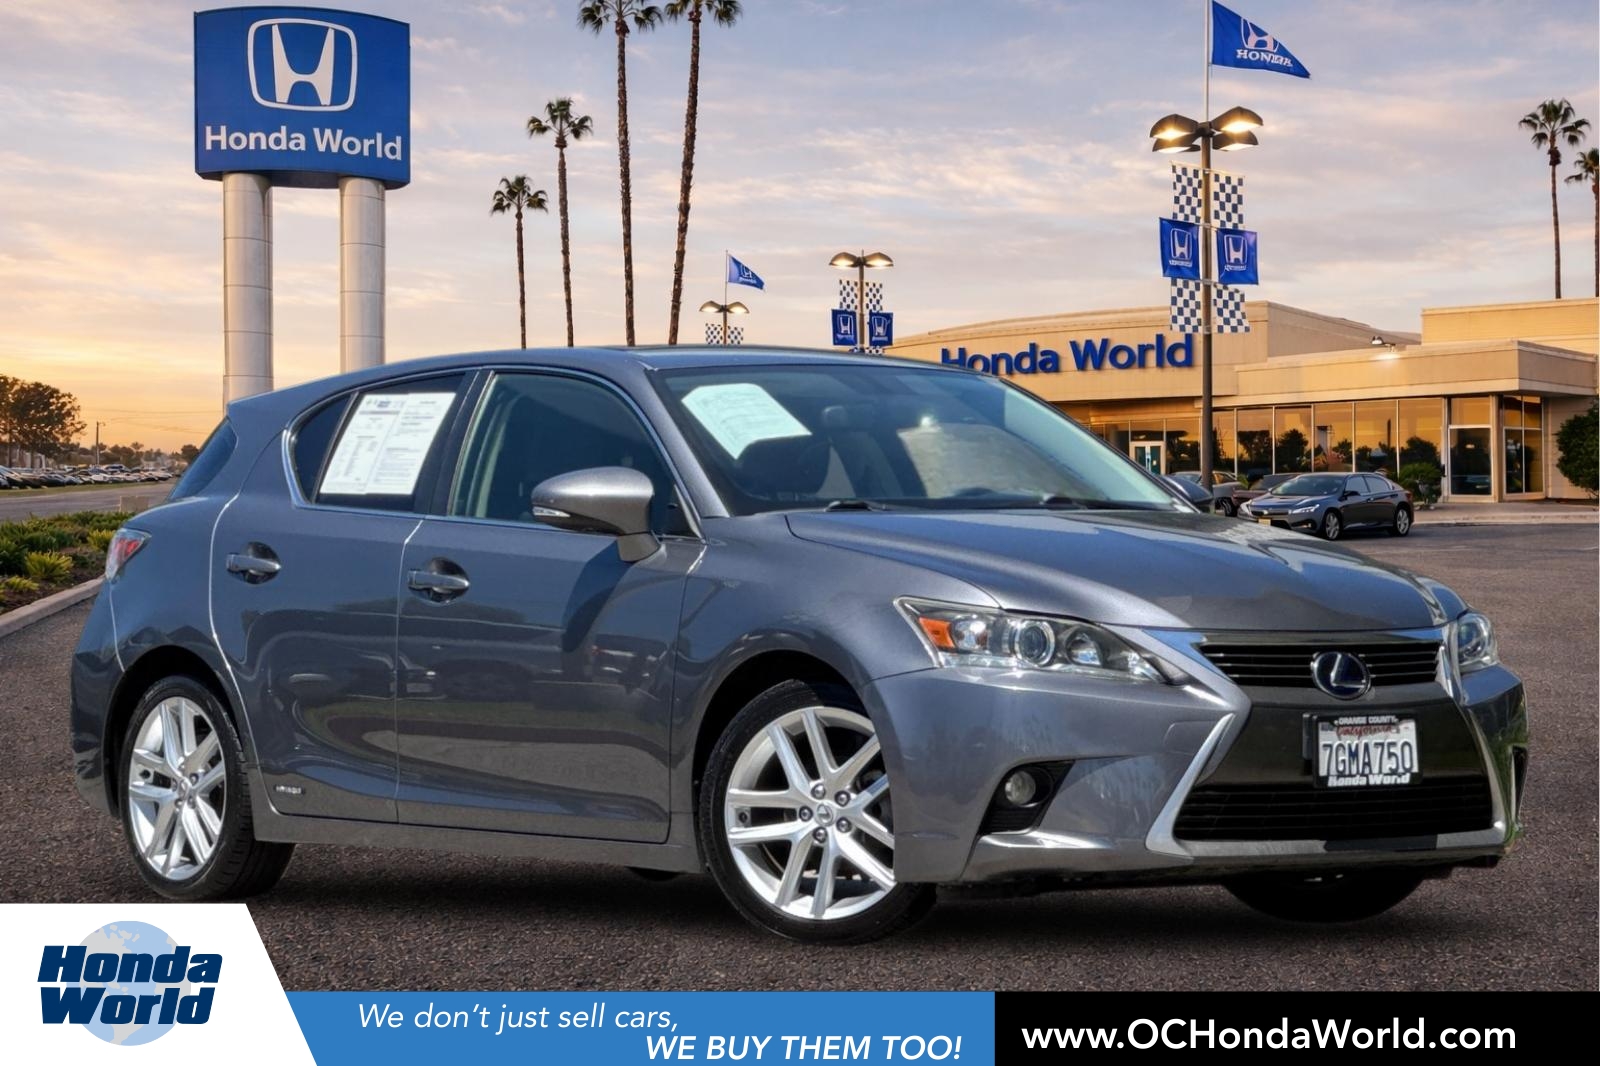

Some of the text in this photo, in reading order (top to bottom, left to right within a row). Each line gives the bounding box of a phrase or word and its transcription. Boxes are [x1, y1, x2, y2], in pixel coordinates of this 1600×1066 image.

[205, 126, 402, 160] Honda World
[941, 333, 1194, 376] Honda World
[1321, 740, 1414, 776] 7GMA750
[1328, 773, 1411, 787] Honda World
